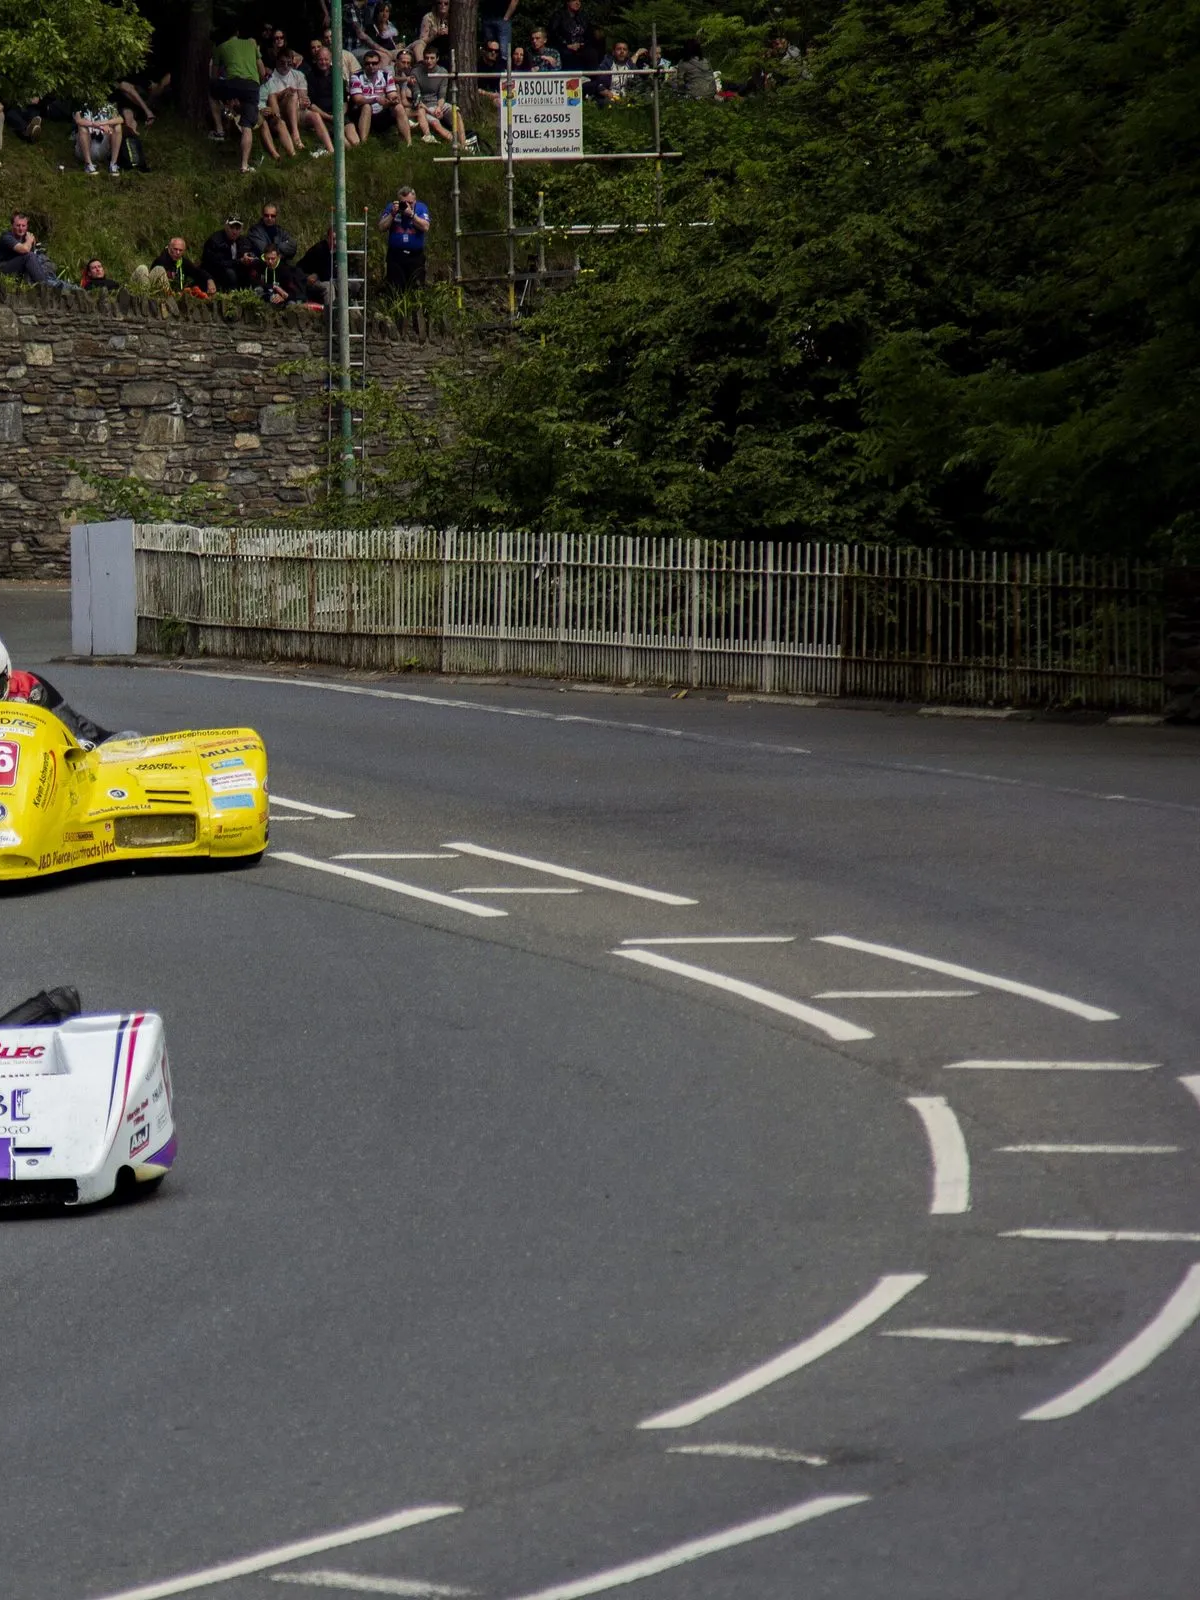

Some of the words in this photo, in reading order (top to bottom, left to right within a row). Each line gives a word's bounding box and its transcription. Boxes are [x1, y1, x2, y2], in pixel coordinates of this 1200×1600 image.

[518, 80, 564, 95] ABSOLUTE
[513, 114, 532, 123] TEL:
[534, 114, 571, 123] 620505
[543, 129, 580, 138] 413955
[523, 145, 580, 153] www.absolute.im
